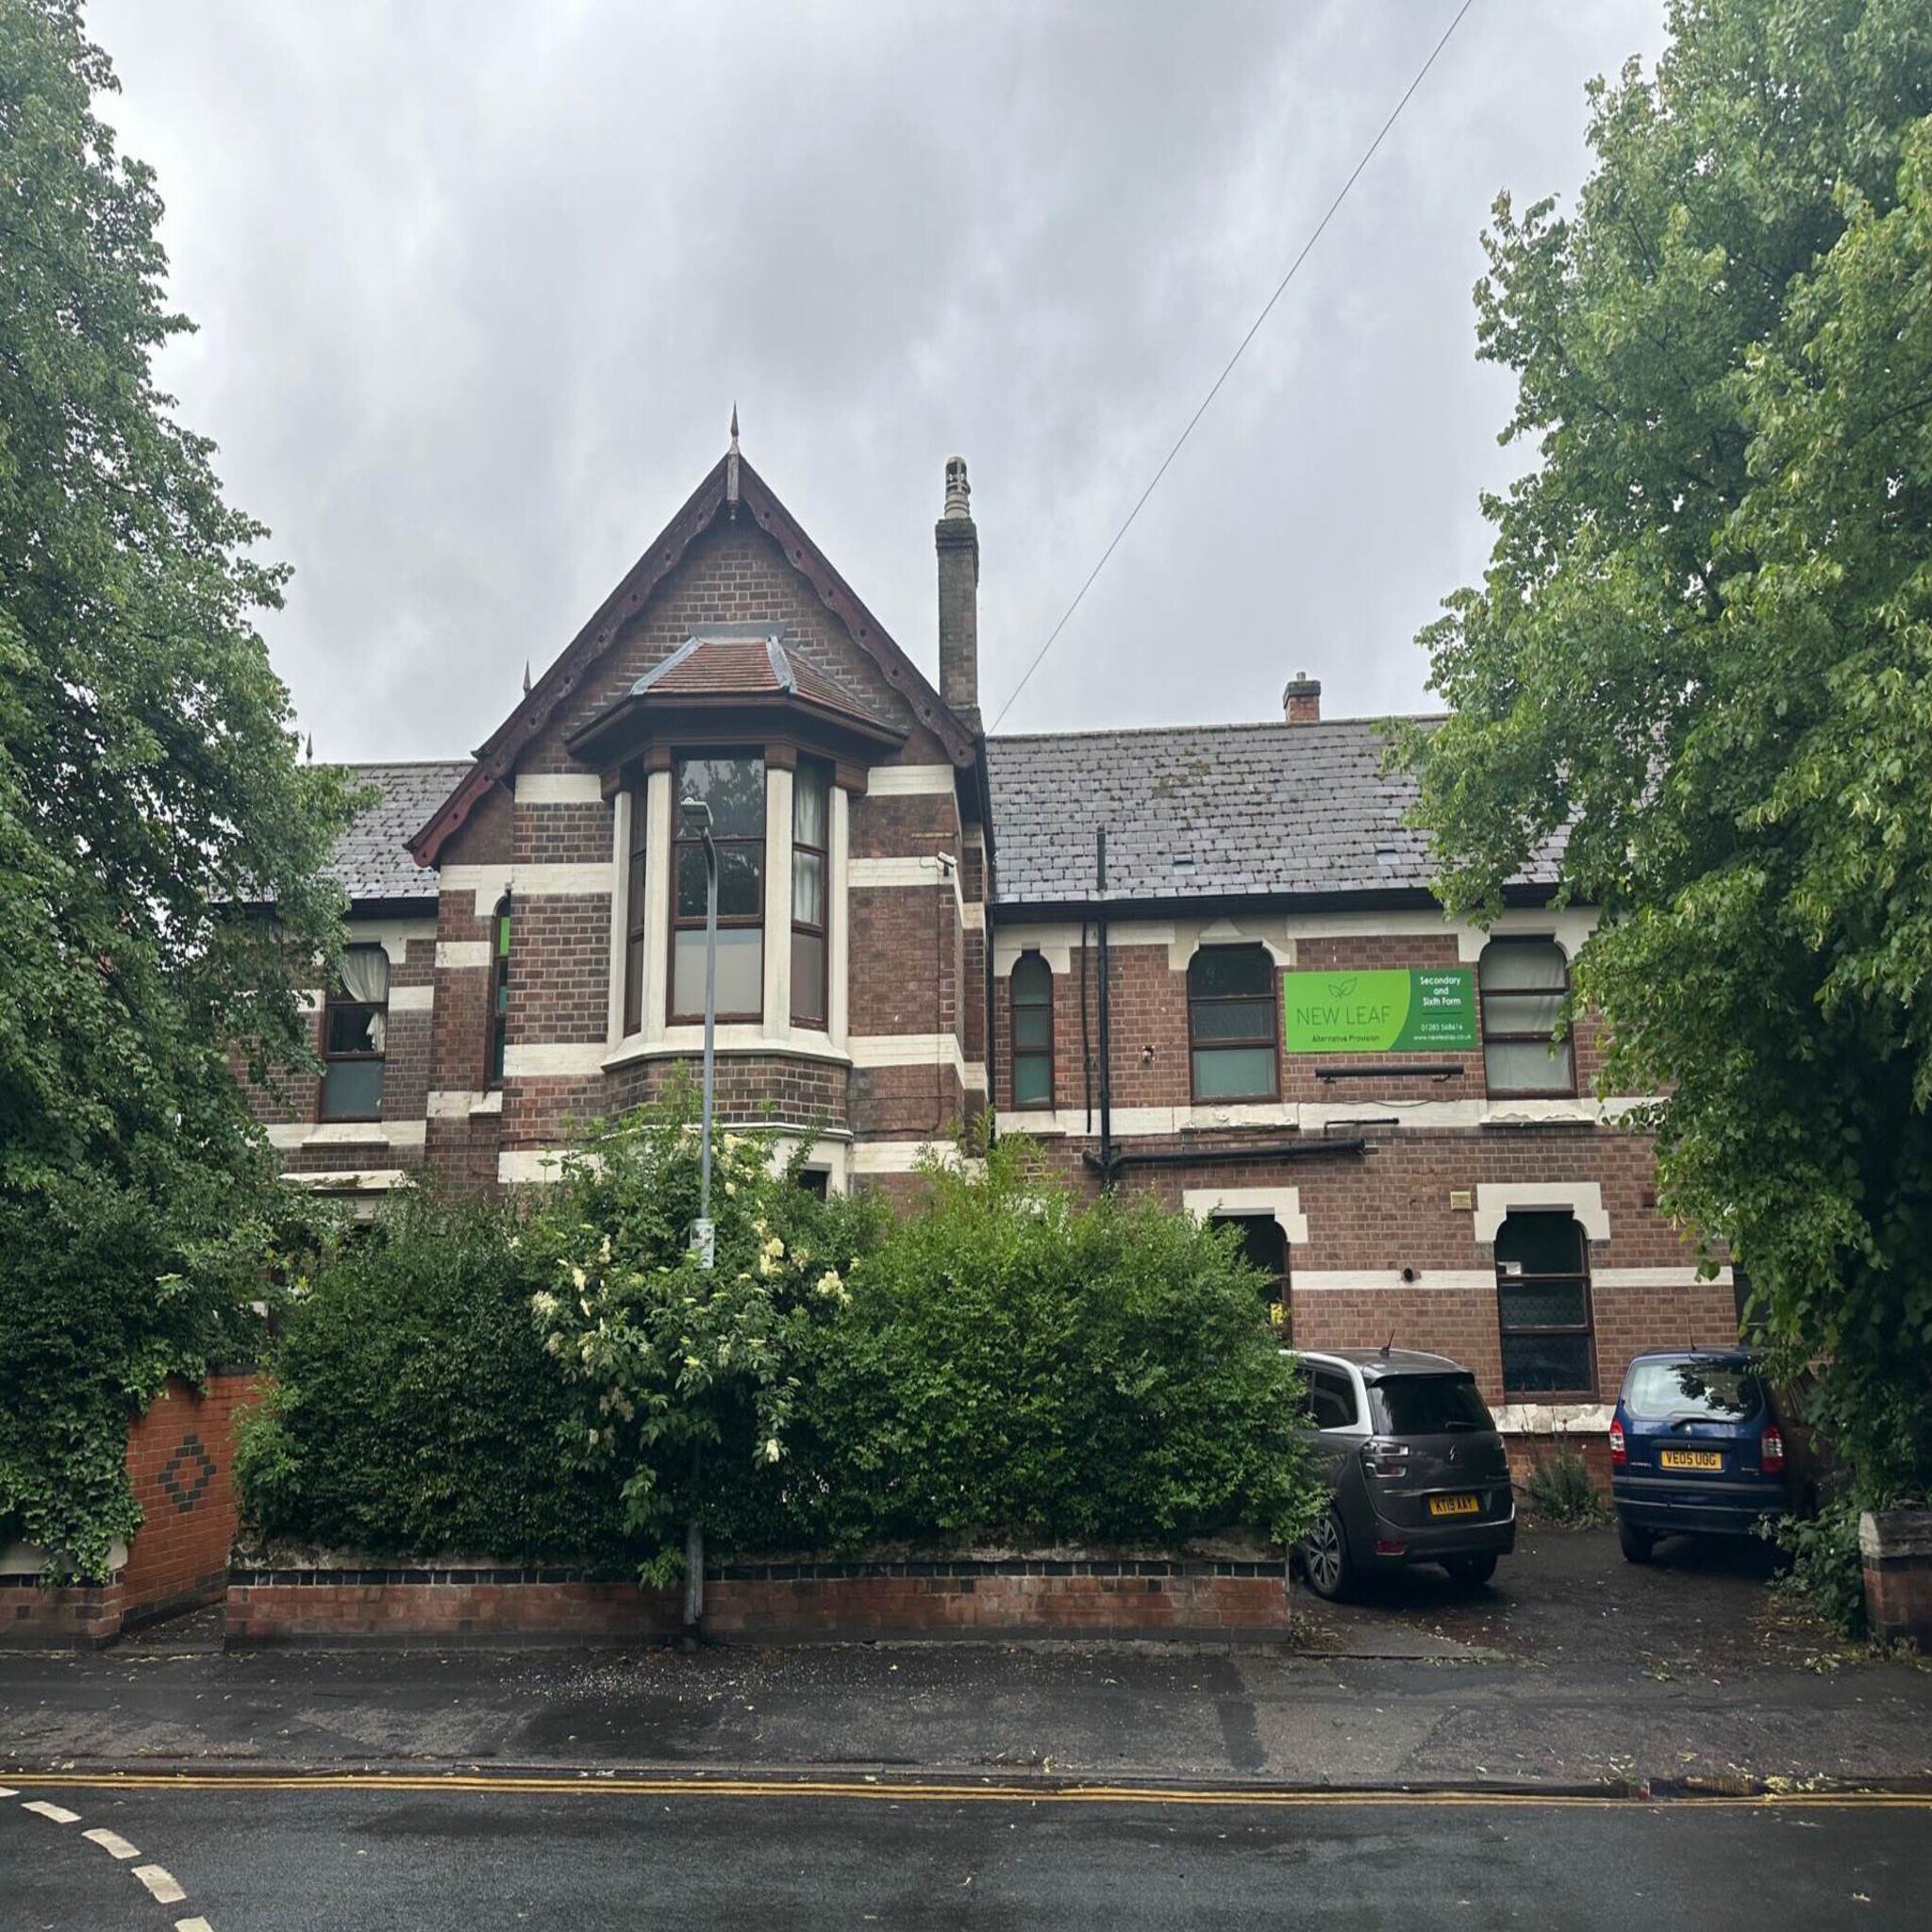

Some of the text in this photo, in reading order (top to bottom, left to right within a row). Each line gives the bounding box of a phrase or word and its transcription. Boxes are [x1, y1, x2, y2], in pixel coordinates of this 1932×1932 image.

[1420, 976, 1461, 986] Secondary
[1434, 987, 1449, 995] and
[1423, 996, 1461, 1007] Sixth Form
[1296, 1006, 1391, 1025] NEW LEAF
[1312, 1034, 1379, 1042] Alternative Provision
[1666, 1451, 1693, 1465] VE05
